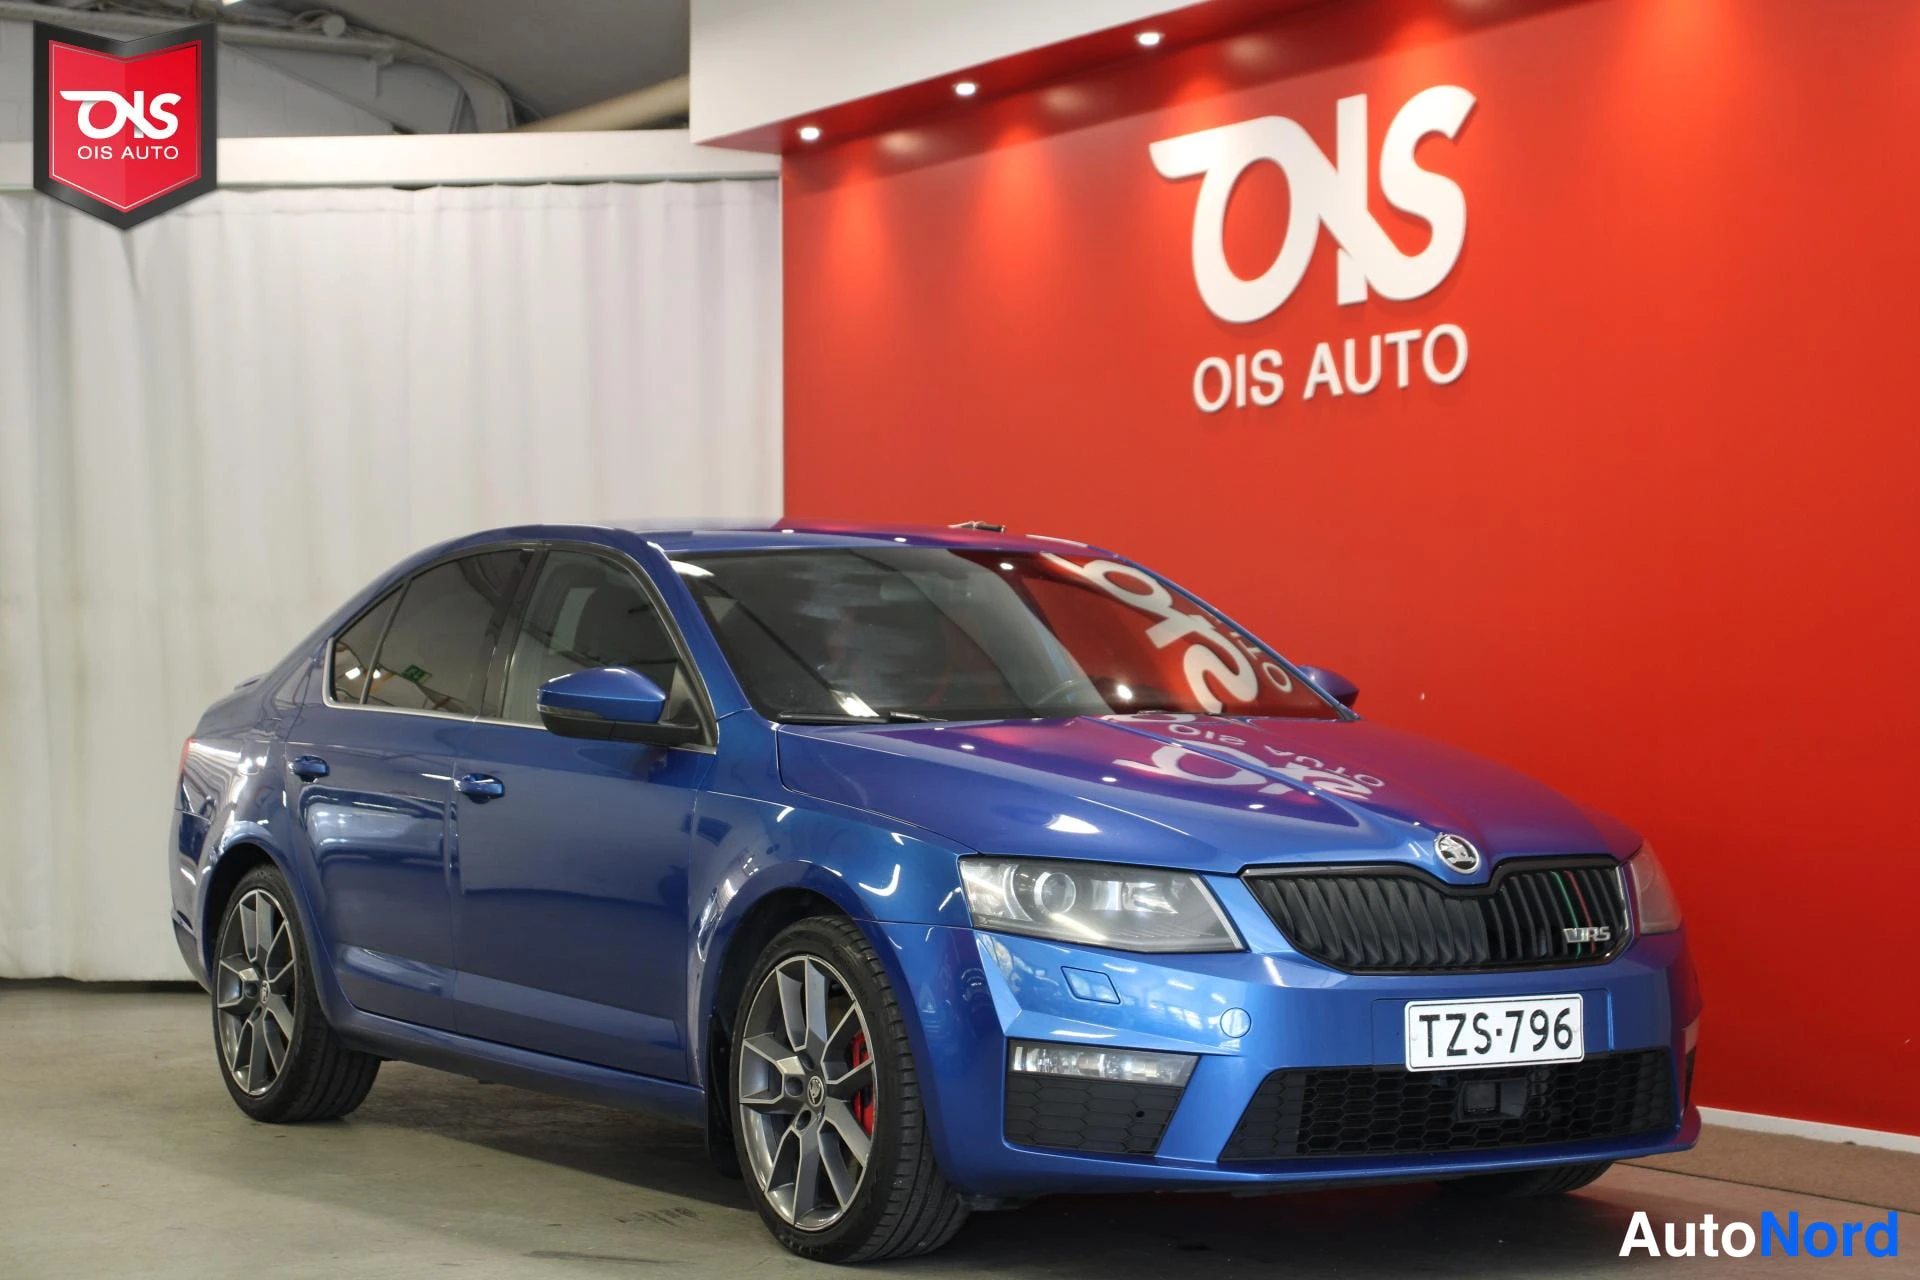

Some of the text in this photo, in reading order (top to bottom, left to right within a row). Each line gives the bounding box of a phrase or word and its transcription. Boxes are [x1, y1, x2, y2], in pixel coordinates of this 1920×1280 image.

[1149, 85, 1477, 324] OIS
[1192, 323, 1468, 413] OIS AUTO
[1418, 1007, 1574, 1058] TZS-796
